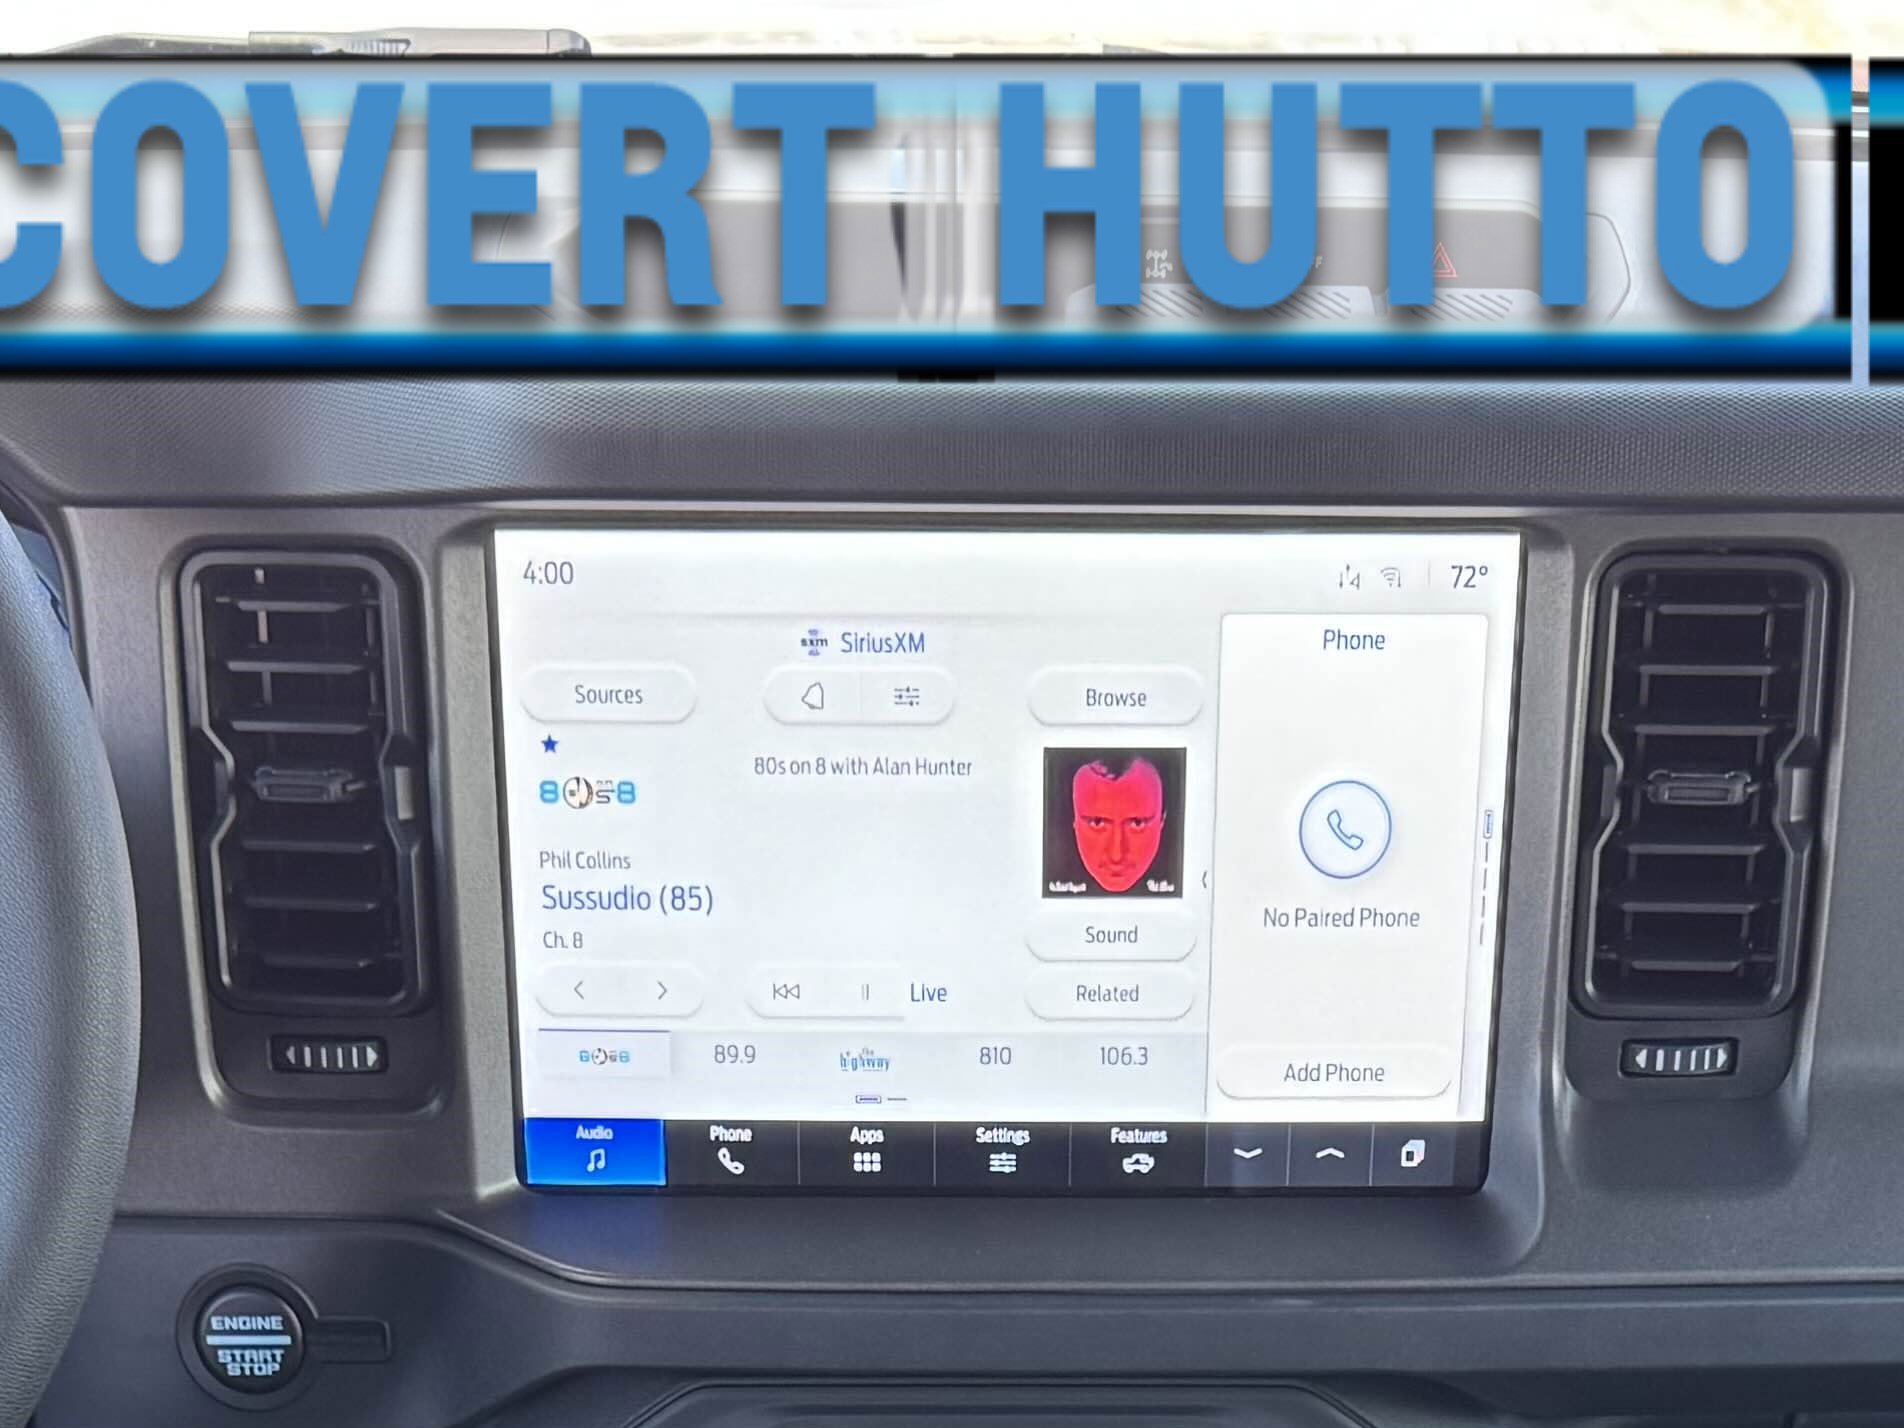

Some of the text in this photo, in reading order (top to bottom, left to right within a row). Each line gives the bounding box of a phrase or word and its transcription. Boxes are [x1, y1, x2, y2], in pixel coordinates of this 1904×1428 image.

[522, 561, 574, 585] 4:00
[1451, 565, 1489, 589] 72°
[841, 632, 925, 653] SiriusXM
[1323, 629, 1386, 652] Phone
[575, 683, 643, 705] Sources
[1086, 689, 1147, 708] Browse
[754, 757, 973, 777] 80s on 8 with Alan Hunter
[539, 850, 632, 870] Phil Collins
[542, 884, 714, 916] Sussudio (85)
[1264, 908, 1421, 928] No Paired Phone
[543, 930, 584, 951] Ch. 8
[1085, 925, 1138, 945] Sound
[909, 982, 948, 1003] Live
[1076, 985, 1139, 1004] Related
[714, 1045, 756, 1064] 89.9
[978, 1047, 1012, 1066] 810
[1100, 1047, 1149, 1066] 106.3
[1284, 1064, 1385, 1083] Add Phone
[576, 1125, 613, 1141] Audio
[710, 1126, 752, 1143] Phone
[850, 1127, 884, 1145] Apps
[976, 1128, 1030, 1146] Settings
[1111, 1128, 1168, 1144] Features
[211, 1315, 284, 1331] ENGINE
[217, 1349, 285, 1363] START
[227, 1363, 280, 1376] STOP
